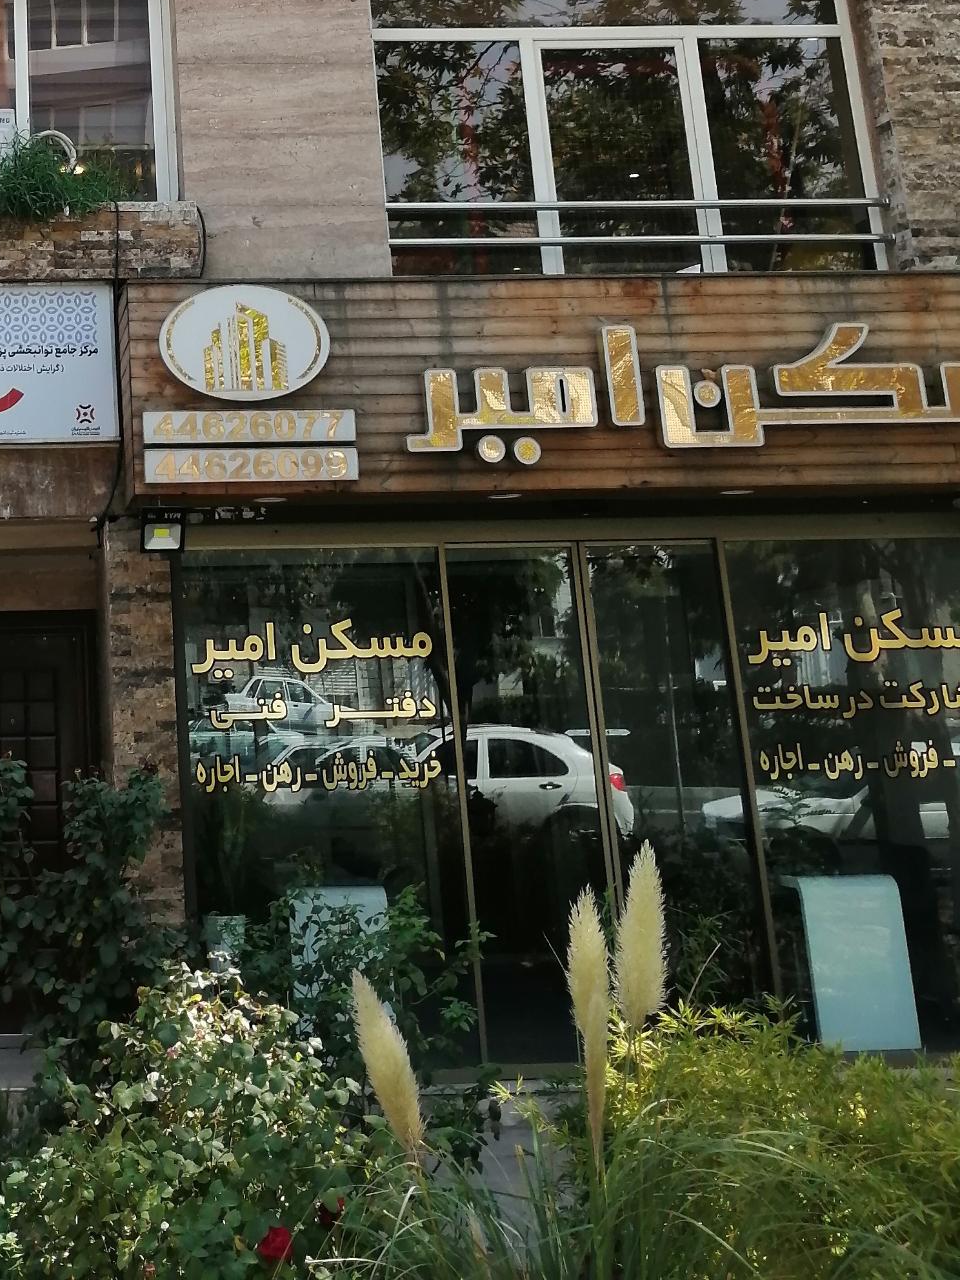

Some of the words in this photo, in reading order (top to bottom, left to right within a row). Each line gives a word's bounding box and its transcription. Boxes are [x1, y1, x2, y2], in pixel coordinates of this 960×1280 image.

[8, 344, 53, 358] توانبخشی
[54, 344, 77, 358] جامع
[78, 345, 99, 357] مرکز
[406, 324, 645, 465] امیر
[153, 411, 344, 441] 44626077
[155, 449, 348, 481] 44626099
[191, 622, 276, 678] امیر
[291, 618, 434, 673] مسکن
[748, 612, 831, 667] امیر
[843, 608, 960, 662] سکن
[210, 691, 288, 729] فنی
[325, 691, 437, 728] دفتر
[752, 684, 840, 710] ساخت
[843, 690, 874, 718] در
[196, 755, 240, 793] اجاره
[262, 759, 302, 792] رهن
[322, 749, 377, 790] فروش
[399, 750, 442, 788] خرید
[759, 742, 804, 780] اجاره
[824, 749, 864, 780] رهن
[883, 739, 939, 778] فروش
